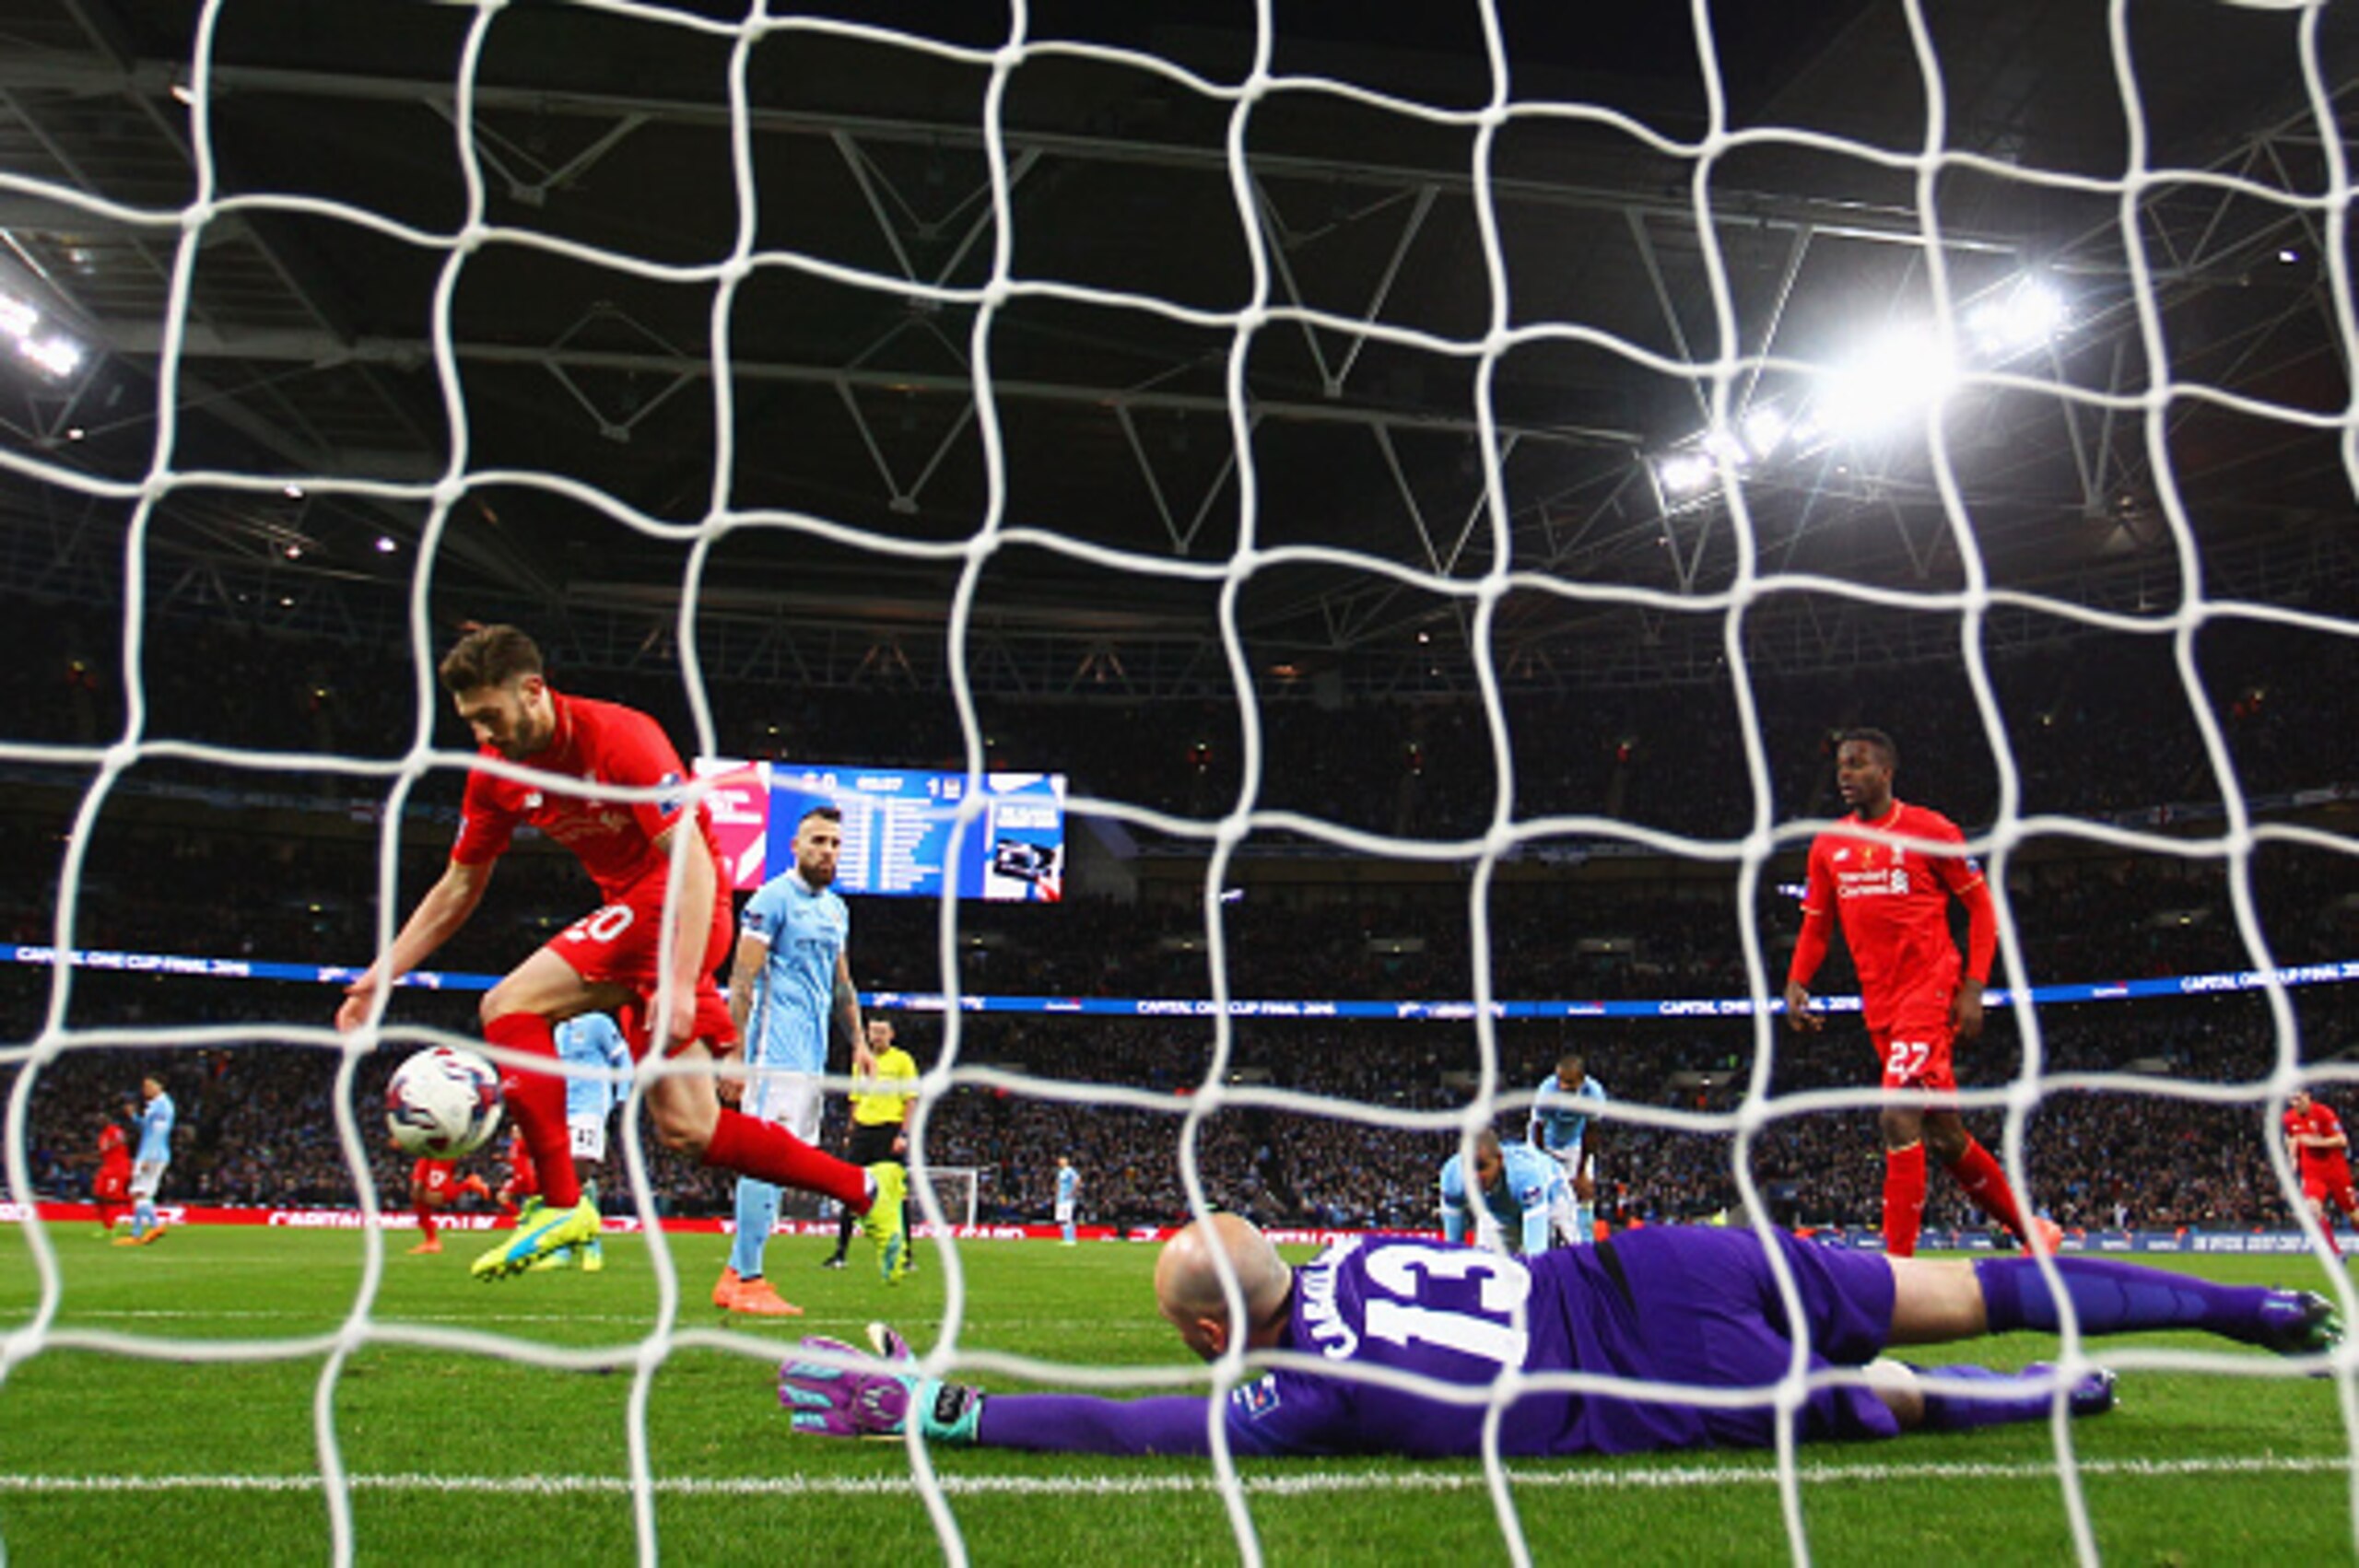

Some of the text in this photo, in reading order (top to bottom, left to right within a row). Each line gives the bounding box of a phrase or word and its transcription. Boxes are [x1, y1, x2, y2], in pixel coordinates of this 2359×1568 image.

[16, 946, 84, 965] CAPIL
[1136, 1000, 1191, 1014] CAPITAL
[1886, 1041, 1930, 1073] 27
[1366, 1244, 1531, 1367] 13
